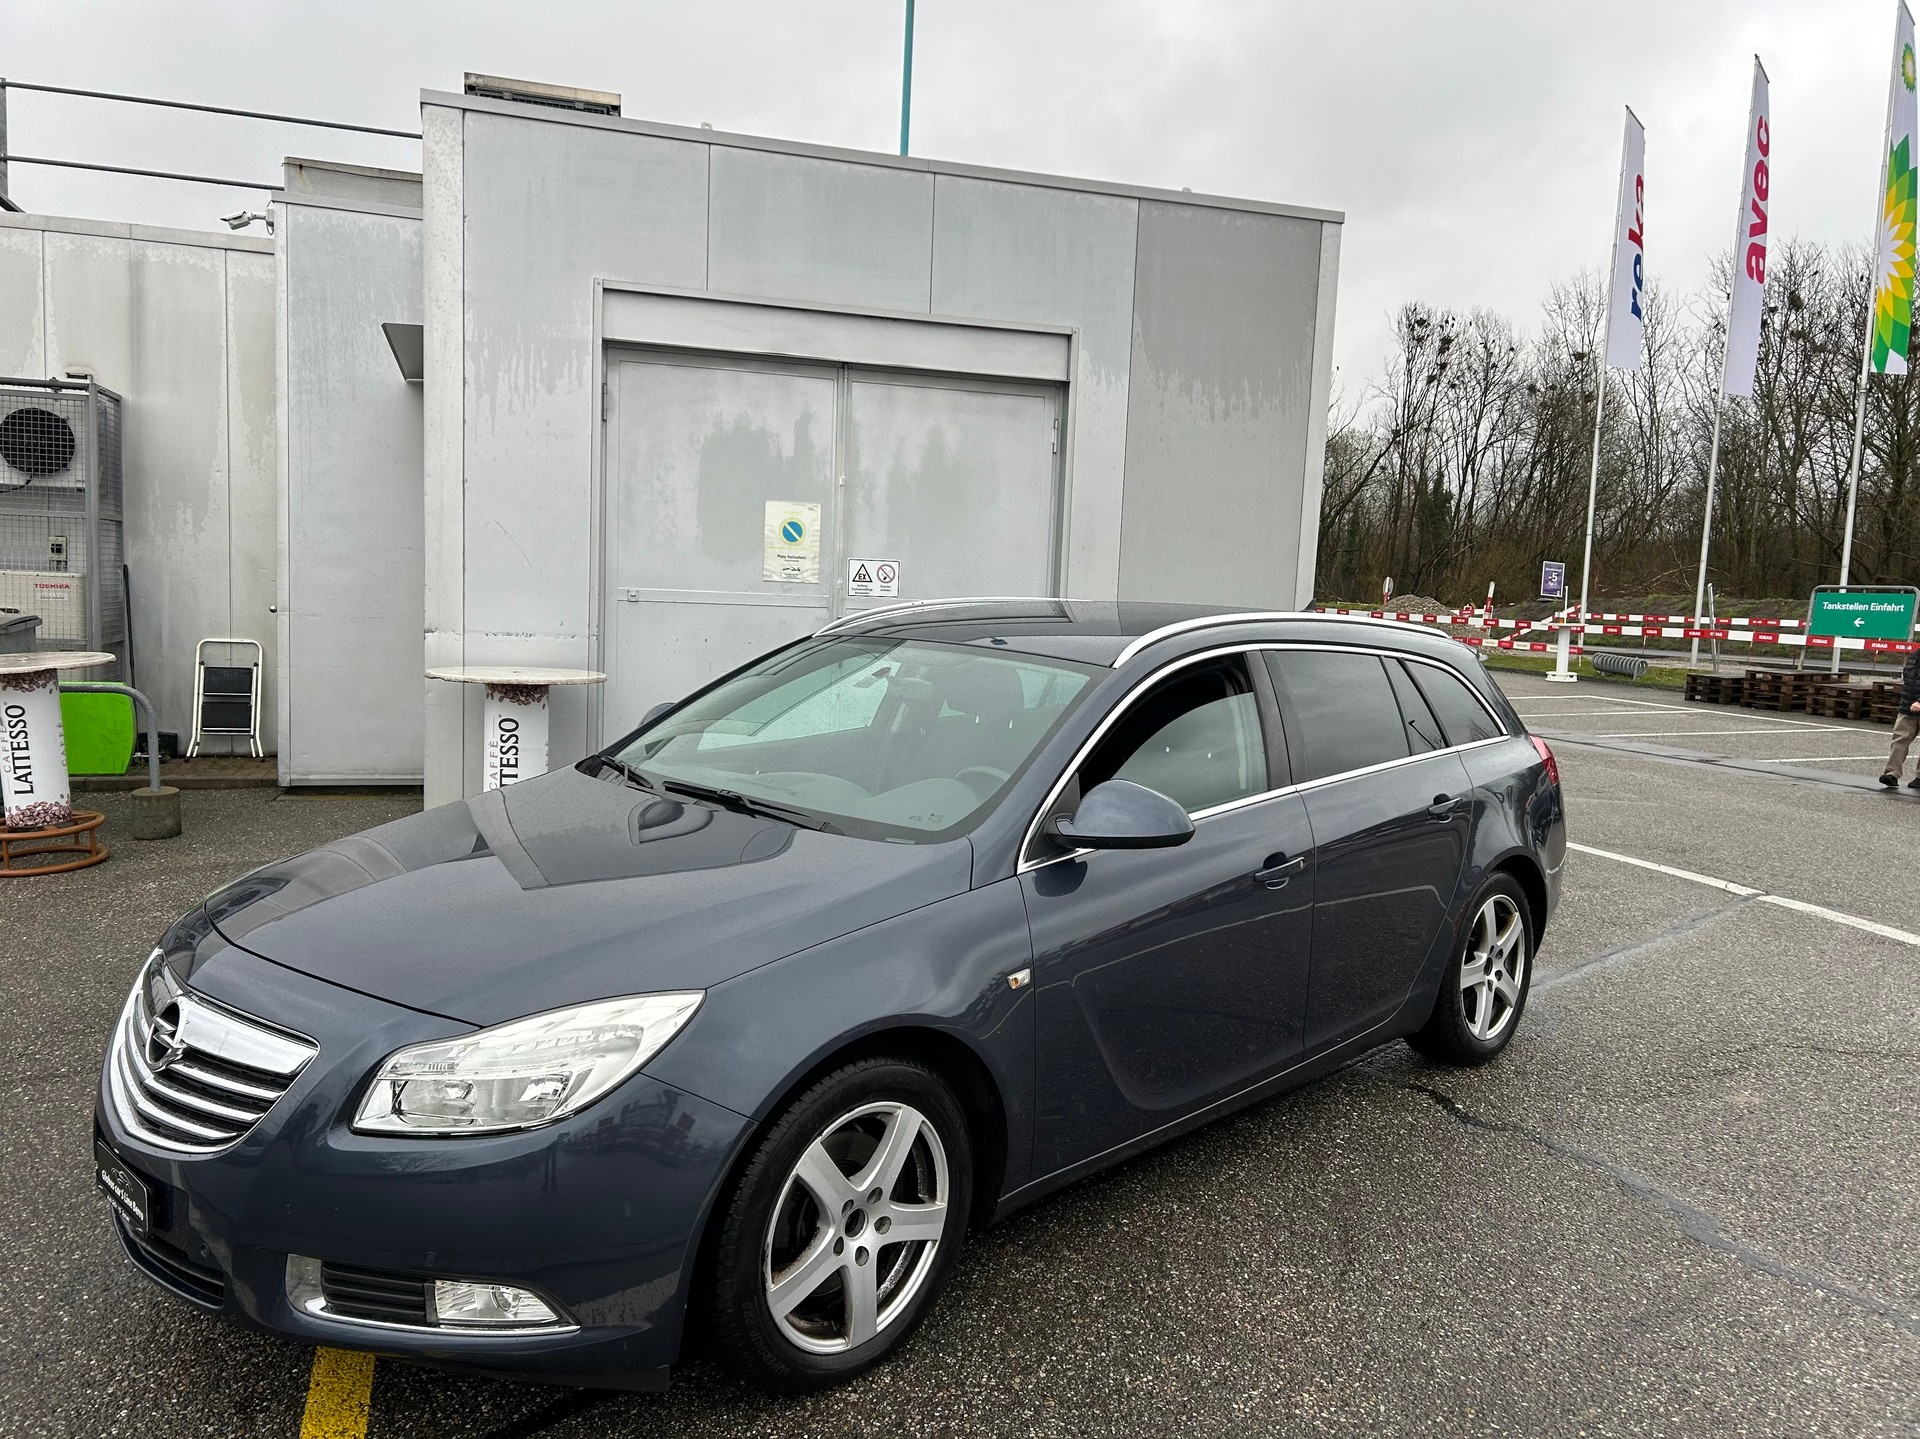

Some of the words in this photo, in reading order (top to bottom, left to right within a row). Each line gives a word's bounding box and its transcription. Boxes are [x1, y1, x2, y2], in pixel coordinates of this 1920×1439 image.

[1628, 174, 1644, 322] reka
[1746, 114, 1770, 285] avec
[1822, 601, 1868, 611] Tankstellen
[1870, 603, 1905, 612] Einfahrt
[5, 704, 34, 795] LATTESSO
